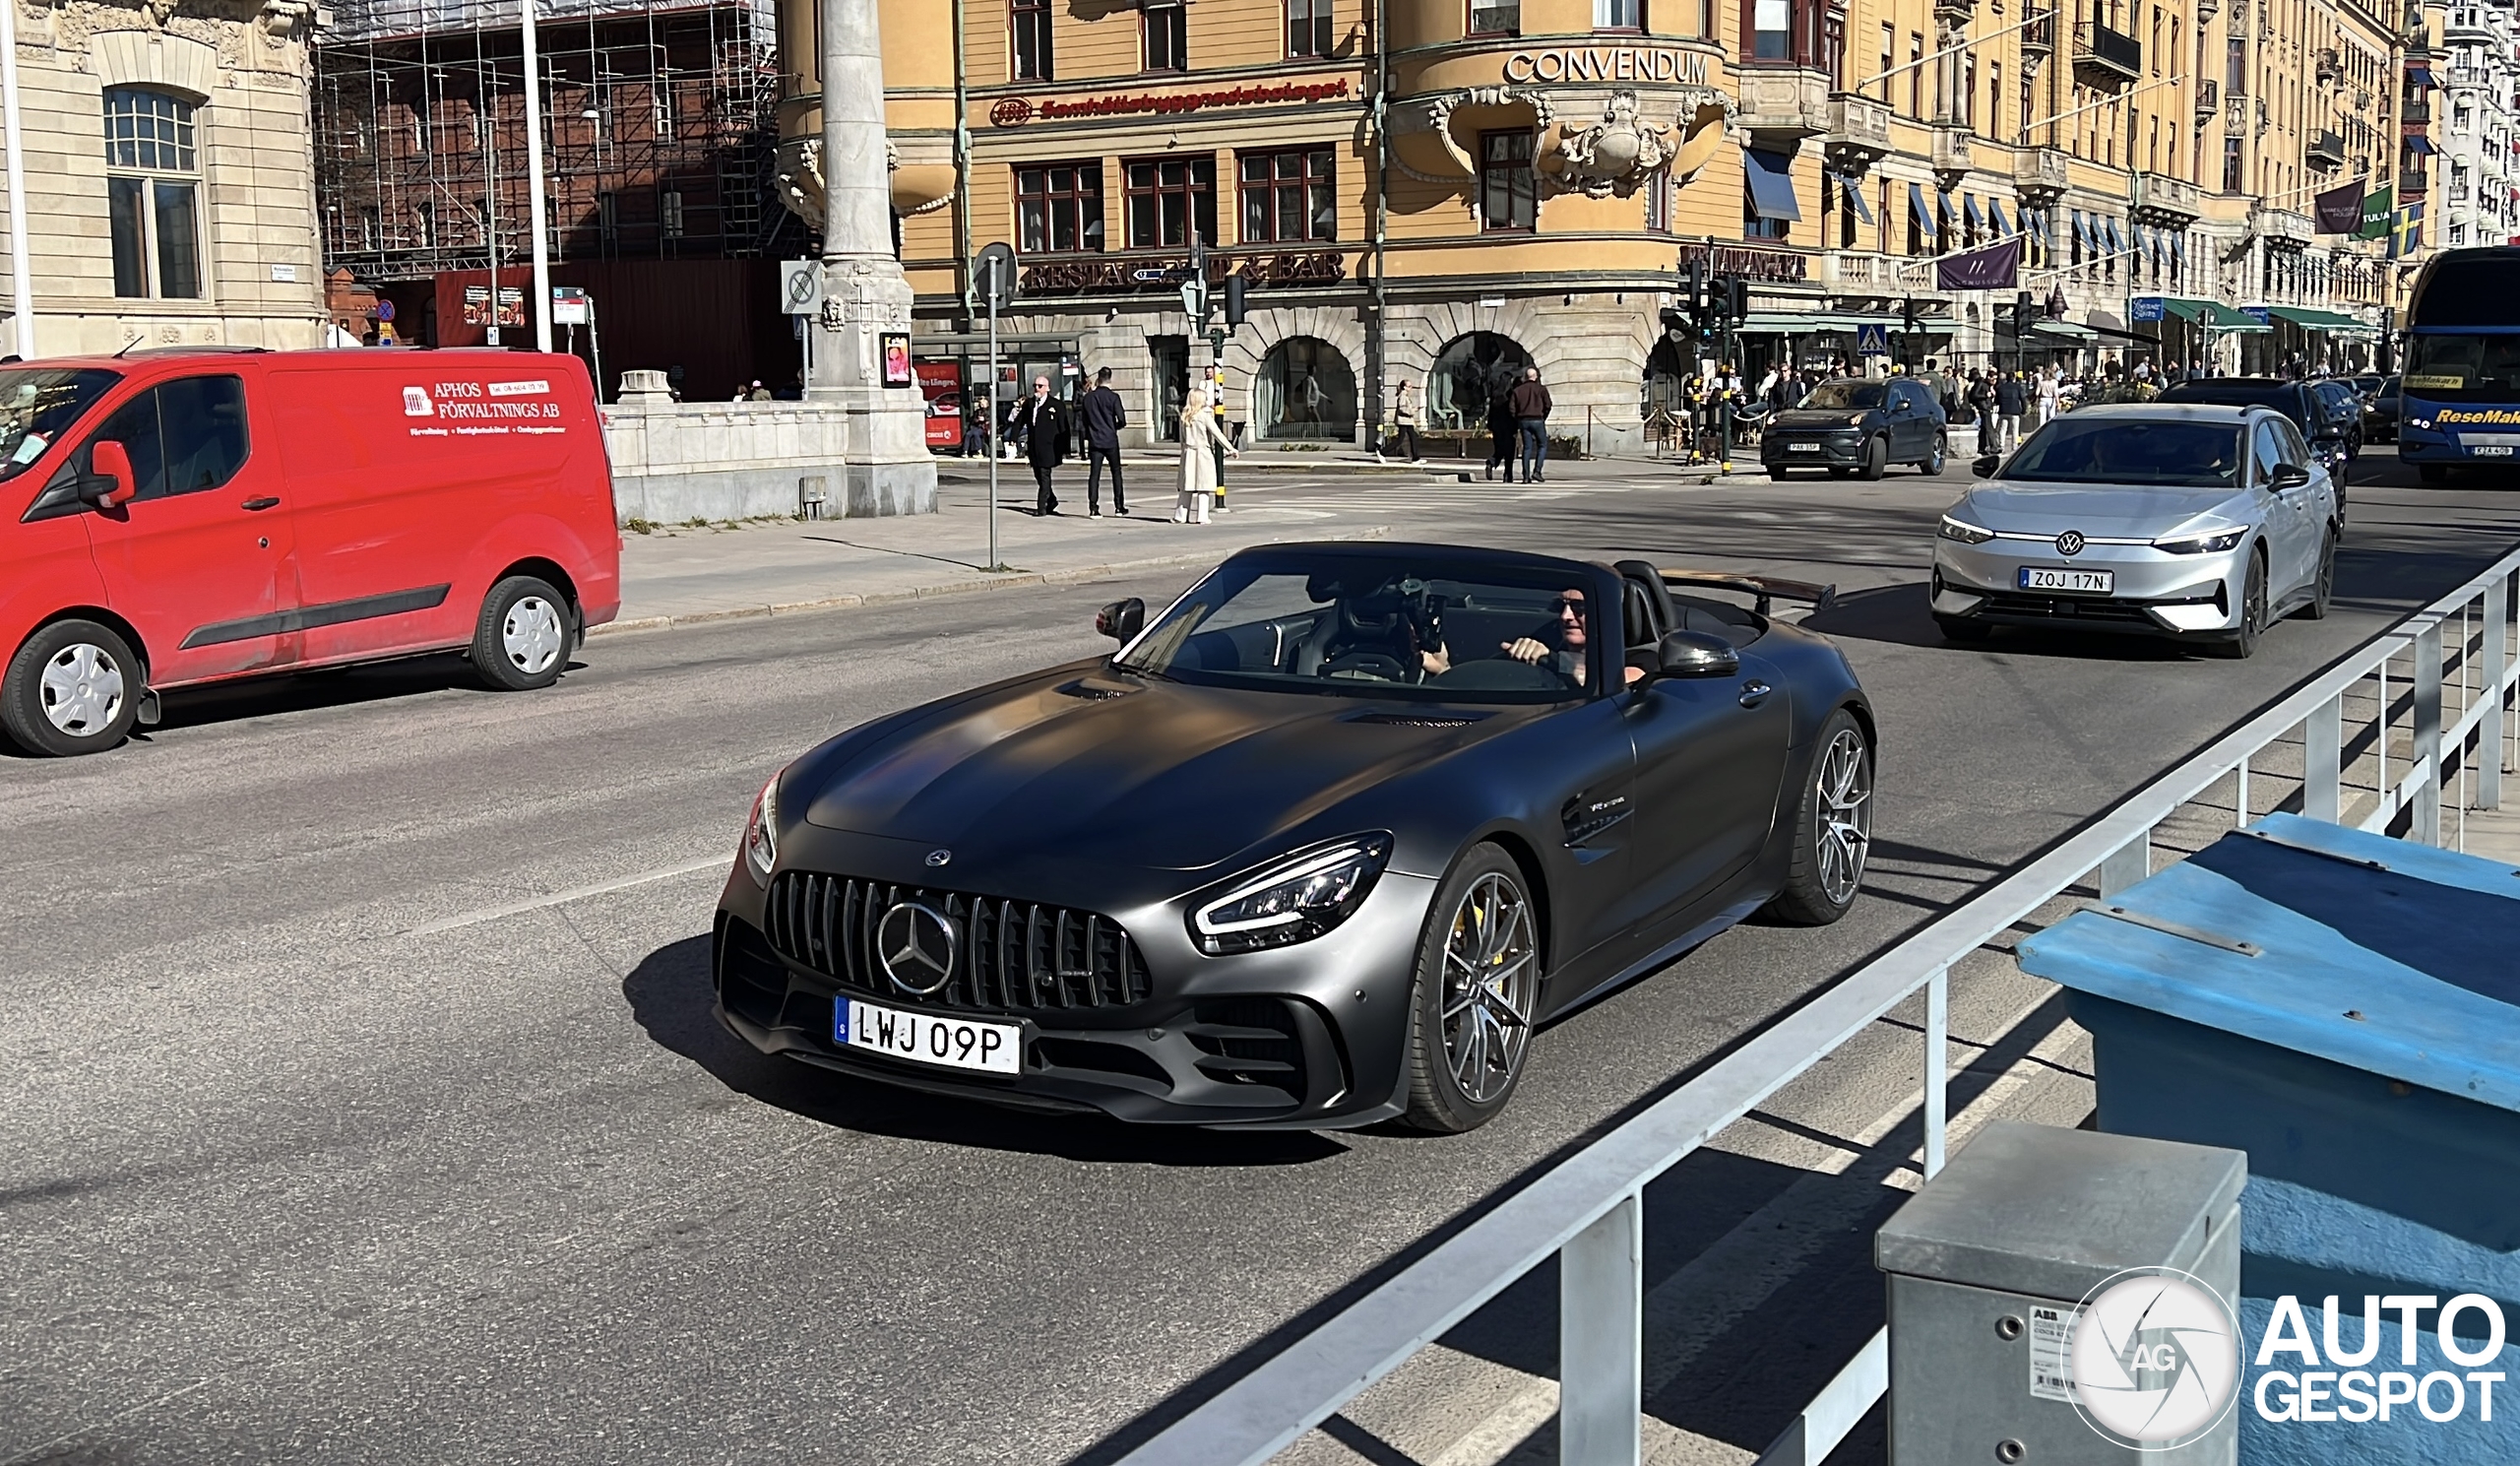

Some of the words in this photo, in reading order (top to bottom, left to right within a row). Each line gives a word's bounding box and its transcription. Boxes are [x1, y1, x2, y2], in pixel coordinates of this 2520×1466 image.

[1505, 48, 1708, 84] CONVENDUM
[1040, 78, 1349, 117] Samhällsbyggnadsbolaget
[1029, 257, 1231, 288] RESTAURAT
[1242, 257, 1270, 281] &
[1280, 252, 1346, 279] BAR
[434, 382, 481, 398] APHOS
[438, 401, 539, 418] FÖRVALTNINGS
[542, 403, 560, 417] AB
[2035, 572, 2065, 587] ZOJ
[2074, 574, 2104, 589] 17N
[859, 1006, 915, 1052] LWJ
[930, 1022, 1002, 1064] 09P
[2034, 1308, 2058, 1321] ABB
